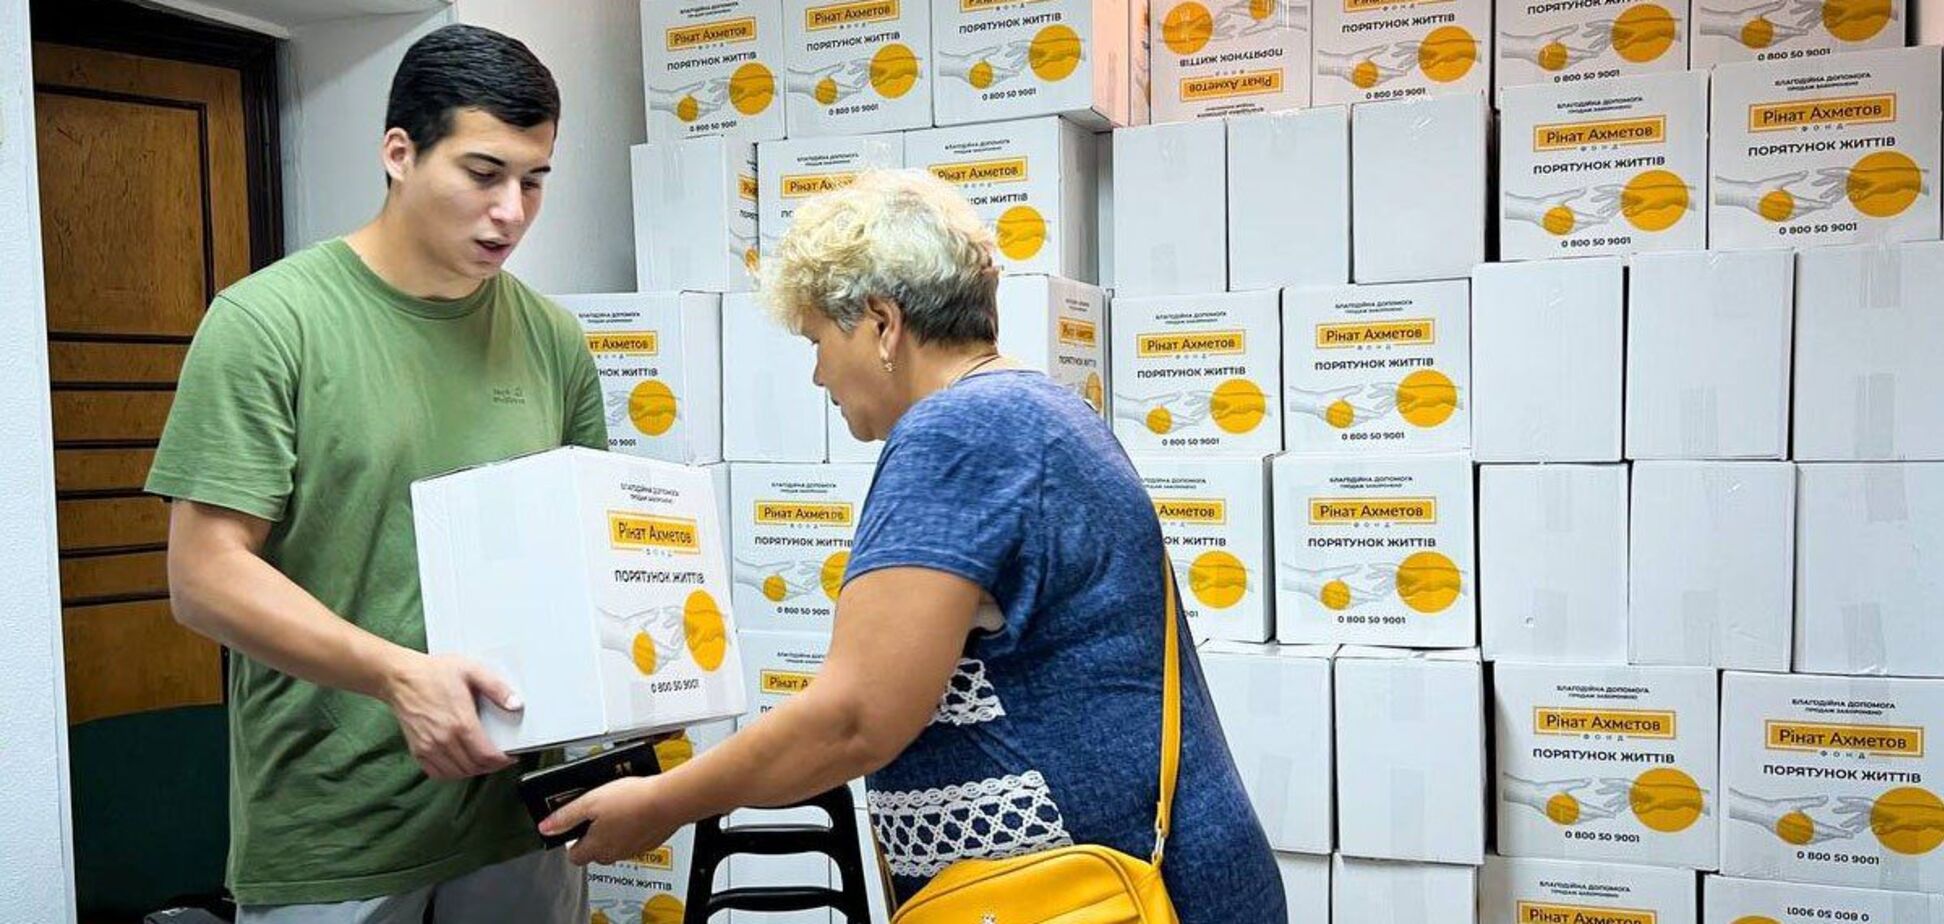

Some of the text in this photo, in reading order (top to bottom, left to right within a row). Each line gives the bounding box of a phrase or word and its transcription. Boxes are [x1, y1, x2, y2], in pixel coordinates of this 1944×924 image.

[815, 5, 890, 23] Рінат Ахметов
[959, 12, 1062, 33] ПОРЯТУНОК ЖИТТІВ
[1342, 13, 1455, 33] ПОРЯТУНОК ЖИТТІВ
[807, 32, 900, 52] ПОРЯТУНОК ЖИТТІВ
[1180, 48, 1283, 67] ПОРЯТУНОК ЖИТТІВ
[1767, 52, 1788, 60] 800
[1790, 51, 1803, 59] 50
[1806, 48, 1832, 57] 9001
[667, 51, 757, 71] ПОРЯТУНОК ЖИТТІВ
[1554, 69, 1620, 83] 0 800 50 9001
[1189, 76, 1272, 92] Рінат Ахметов
[982, 88, 1037, 101] 0 800 50 9001
[1405, 88, 1426, 96] 9001
[1763, 104, 1881, 124] Рінат Ахметов
[1547, 126, 1653, 143] Рінат Ахметов
[1748, 136, 1896, 157] ПОРЯТУНОК ЖИТТІВ
[1534, 156, 1665, 174] ПОРЯТУНОК ЖИТТІВ
[969, 166, 1018, 179] Ахметов
[790, 181, 817, 192] Рінат
[990, 193, 1028, 205] ЖИТТІВ
[1779, 223, 1858, 235] 0 800 50 9001
[1561, 237, 1631, 248] 0 800 50 9001
[1326, 329, 1422, 341] Рінат Ахметов
[602, 339, 648, 349] Ахметов
[1147, 338, 1235, 351] Рінат Ахметов
[1315, 358, 1434, 371] ПОРЯТУНОК ЖИТТІВ
[622, 368, 658, 377] ЖИТТІВ
[1137, 366, 1246, 379] ПОРЯТУНОК ЖИТТІВ
[1341, 433, 1347, 441] 0
[764, 507, 792, 517] Рінат
[1159, 506, 1215, 517] Ахметов
[1320, 505, 1423, 518] Рінат Ахметов
[618, 523, 692, 544] Рінат Ахметов
[755, 536, 814, 546] ПОРЯТУНОК
[1183, 537, 1226, 546] ЖИТТІВ
[1308, 538, 1436, 548] ПОРЯТУНОК ЖИТТІВ
[615, 570, 704, 584] ПОРЯТУНОК ЖИТТІВ
[1347, 616, 1365, 624] 800
[1368, 616, 1380, 624] 50
[1383, 616, 1406, 624] 9001
[651, 683, 656, 694] 0
[658, 681, 672, 693] 800
[673, 680, 683, 691] 50
[770, 677, 798, 688] Рінат
[1606, 686, 1650, 694] ДОПОМОГА
[1847, 701, 1896, 710] ДОПОМОГА
[1546, 715, 1660, 731] Рінат Ахметов
[1779, 730, 1906, 749] Рінат Ахметов
[1533, 748, 1675, 764] ПОРЯТУНОК ЖИТТІВ
[1763, 765, 1921, 783] ПОРЯТУНОК ЖИТТІВ
[1565, 831, 1640, 843] 0 800 50 9001
[1797, 851, 1879, 865] 0 800 50 9001
[636, 881, 672, 890] ЖИТТІВ
[1530, 909, 1568, 923] Рінат
[1787, 907, 1869, 922] 0 800 50 9001
